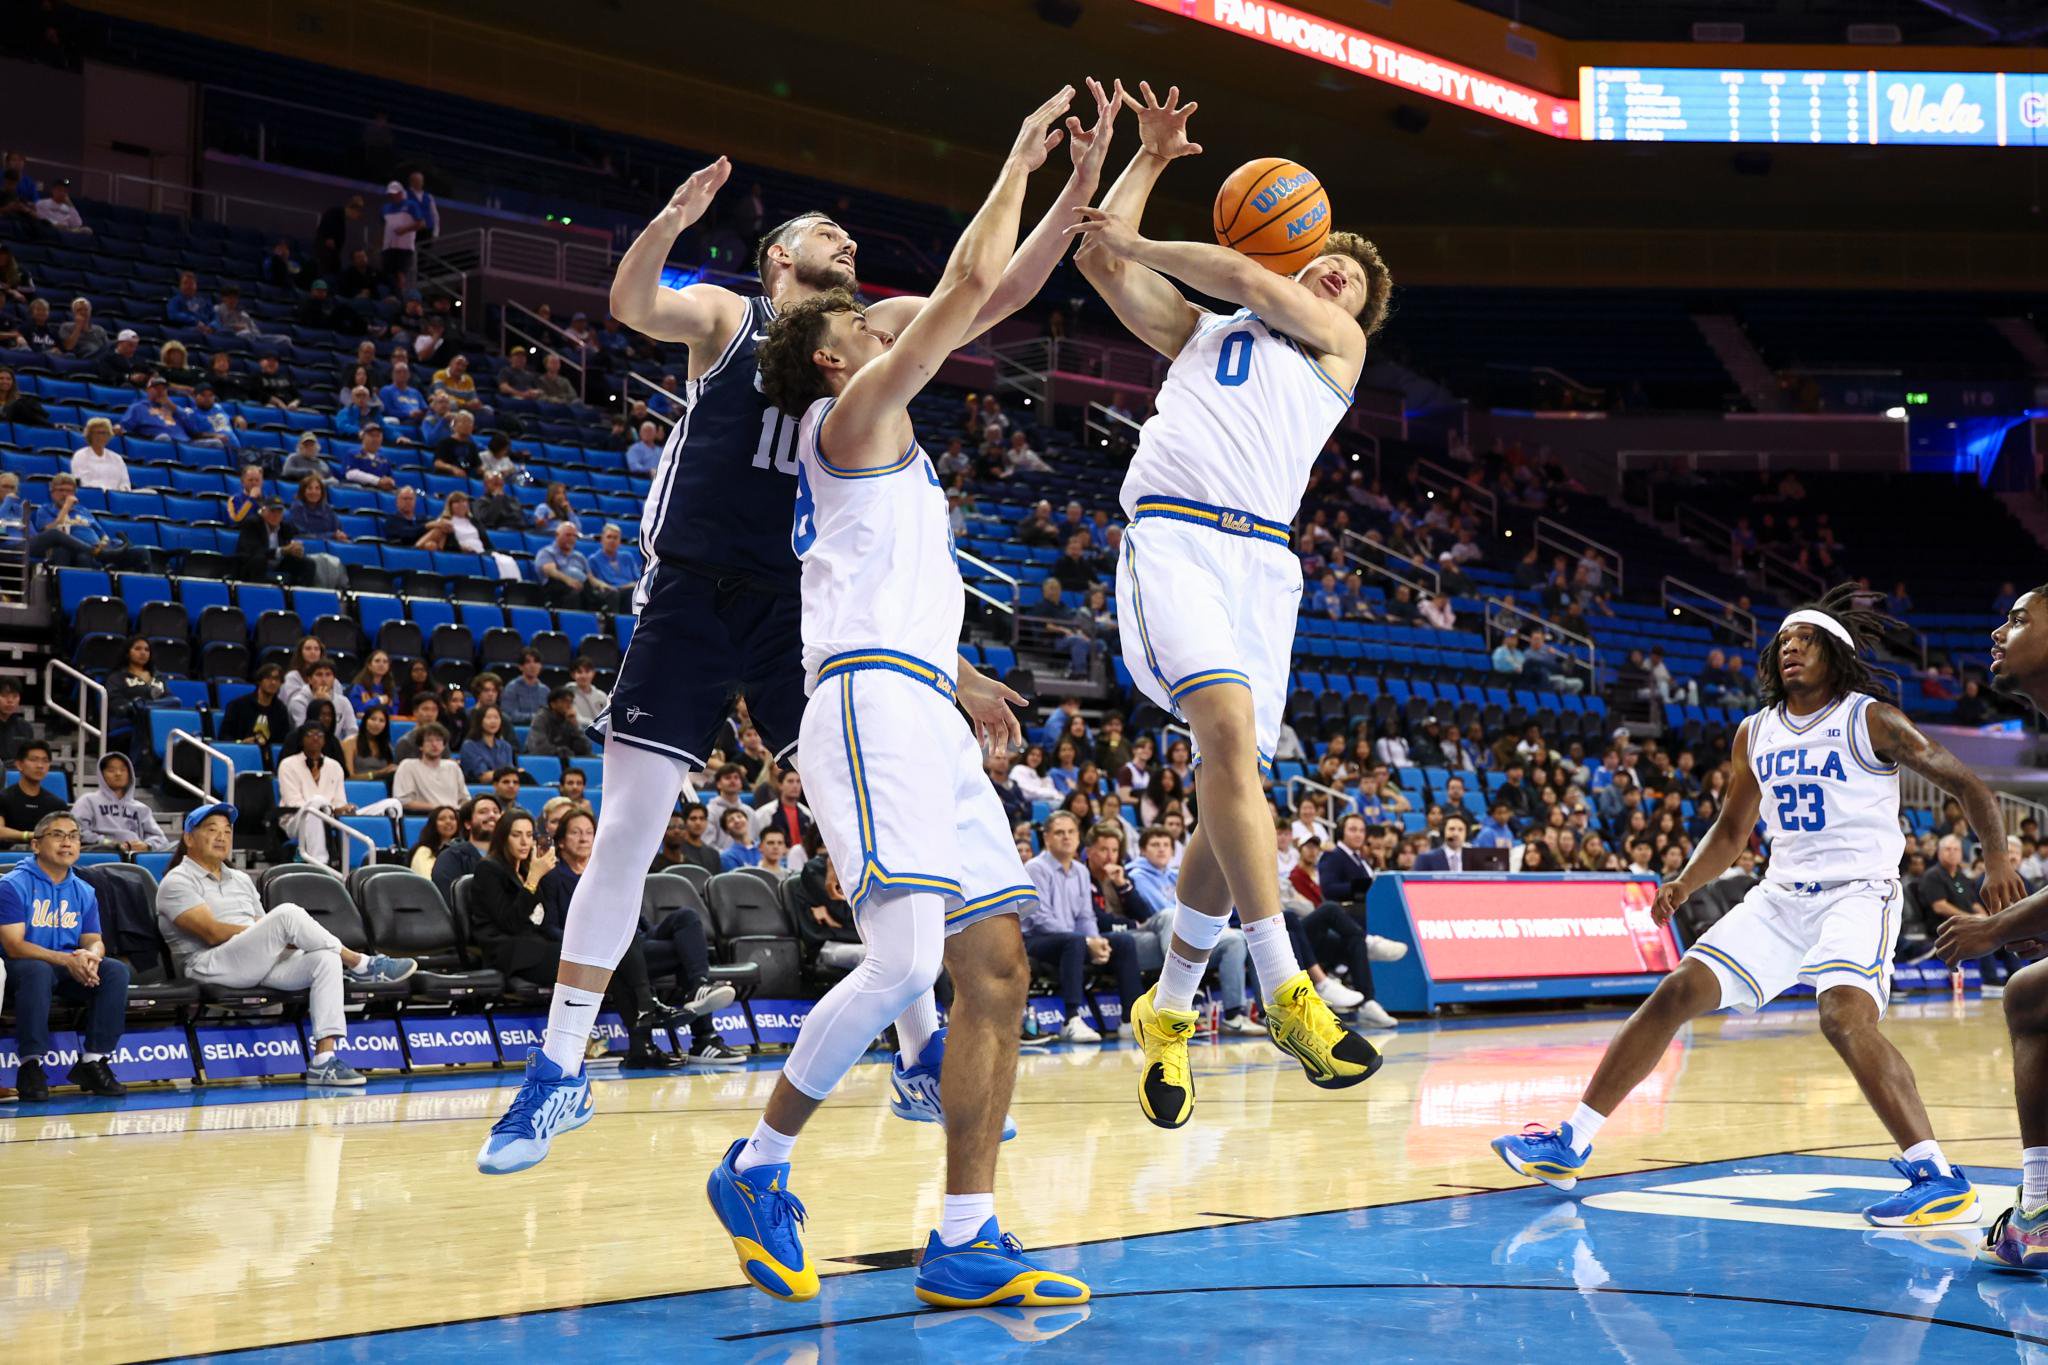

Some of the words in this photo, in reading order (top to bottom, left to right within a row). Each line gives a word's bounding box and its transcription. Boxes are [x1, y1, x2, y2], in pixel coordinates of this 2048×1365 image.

[1214, 0, 1265, 35] FAN
[1267, 9, 1347, 62] WORK
[1348, 36, 1373, 69] IS
[1372, 45, 1470, 100] THIRSTY
[1468, 78, 1539, 124] WORK
[1250, 172, 1316, 213] Wilson
[1286, 201, 1327, 240] NCAA
[1215, 331, 1254, 386] 0
[752, 406, 800, 475] 10
[1222, 511, 1250, 532] Ucla
[1757, 749, 1847, 783] UCLA
[99, 804, 139, 825] UCLA
[1772, 783, 1826, 832] 23
[32, 899, 78, 929] Ucla
[1418, 920, 1452, 939] FAN
[1451, 919, 1504, 939] WORK
[1579, 917, 1629, 936] WORK
[204, 1040, 299, 1060] SEIA.COM
[410, 1030, 491, 1048] SEIA.COM
